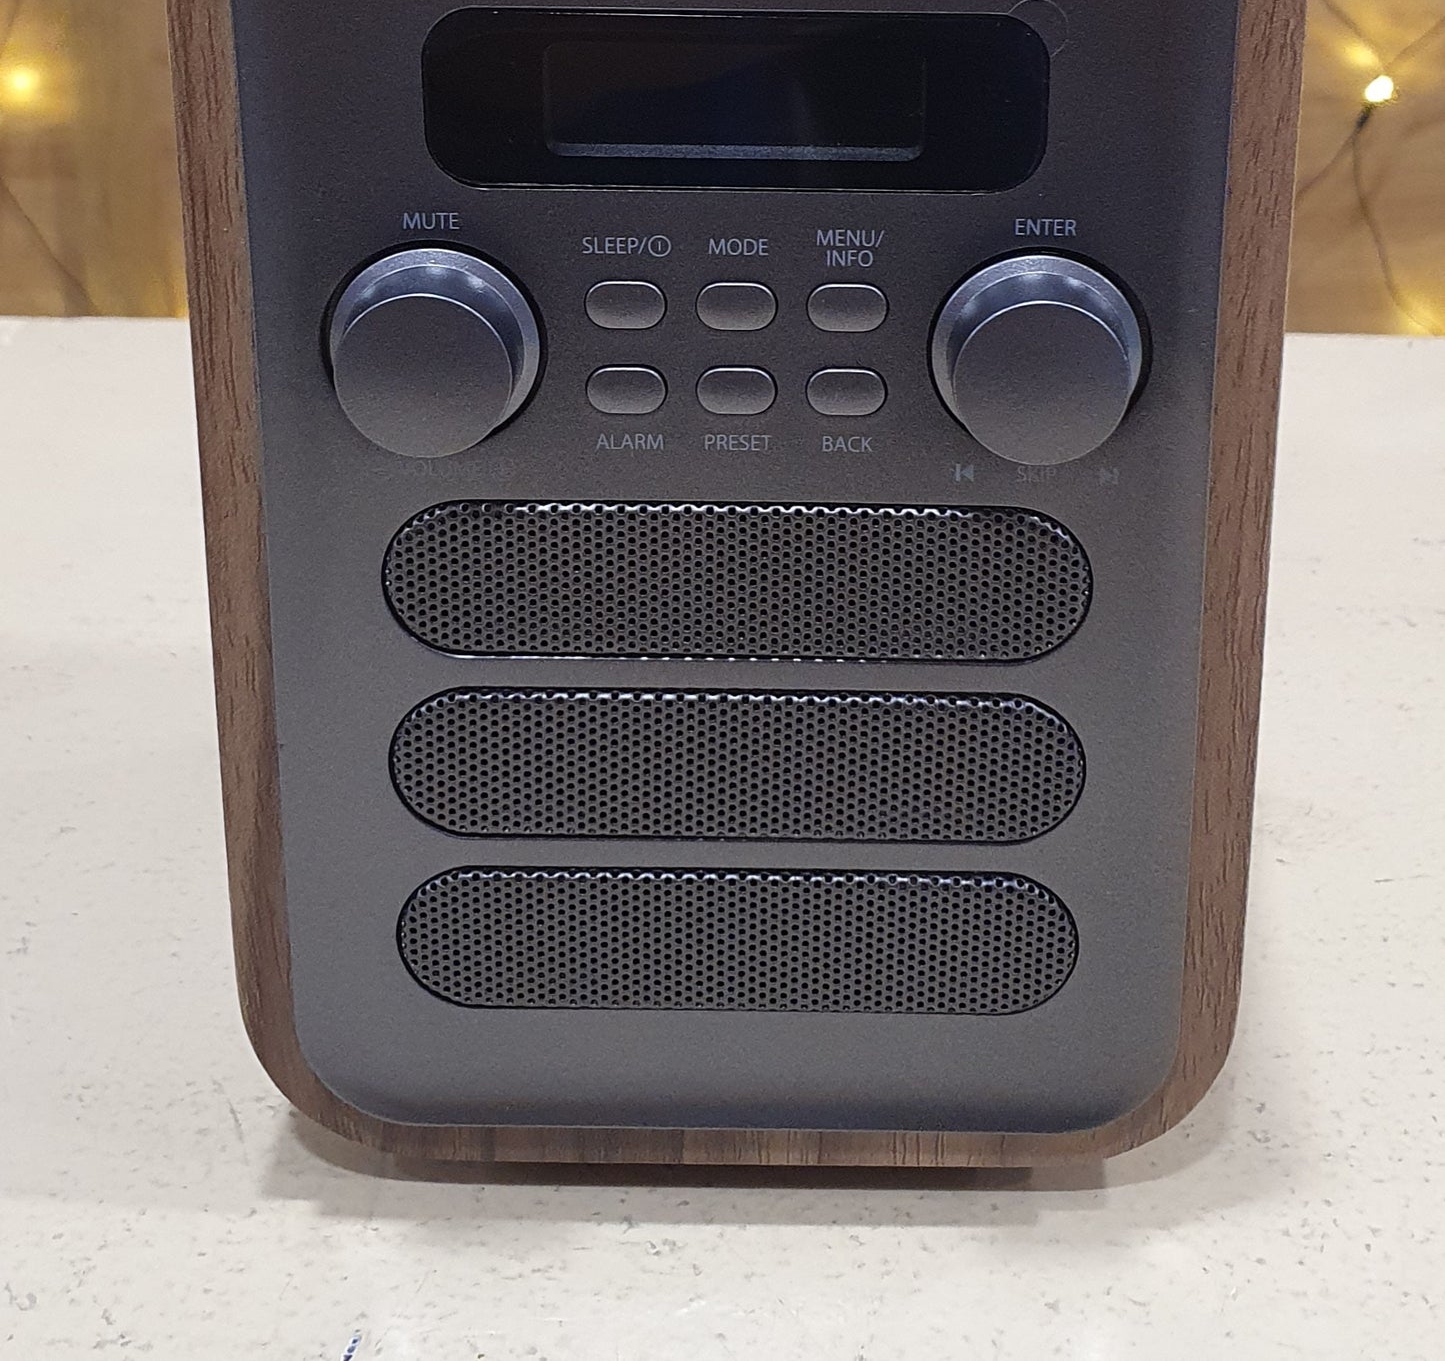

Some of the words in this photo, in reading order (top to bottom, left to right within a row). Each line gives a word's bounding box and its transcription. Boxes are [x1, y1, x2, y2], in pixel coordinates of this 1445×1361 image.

[402, 212, 460, 230] MUTE
[1015, 218, 1077, 237] ENTER
[708, 238, 769, 256] MODE
[816, 229, 885, 248] MENU/
[826, 250, 874, 268] INFO
[597, 434, 665, 450] ALARM
[704, 434, 772, 451] PRESET
[822, 436, 872, 453] BACK
[1016, 465, 1057, 483] SKIP
